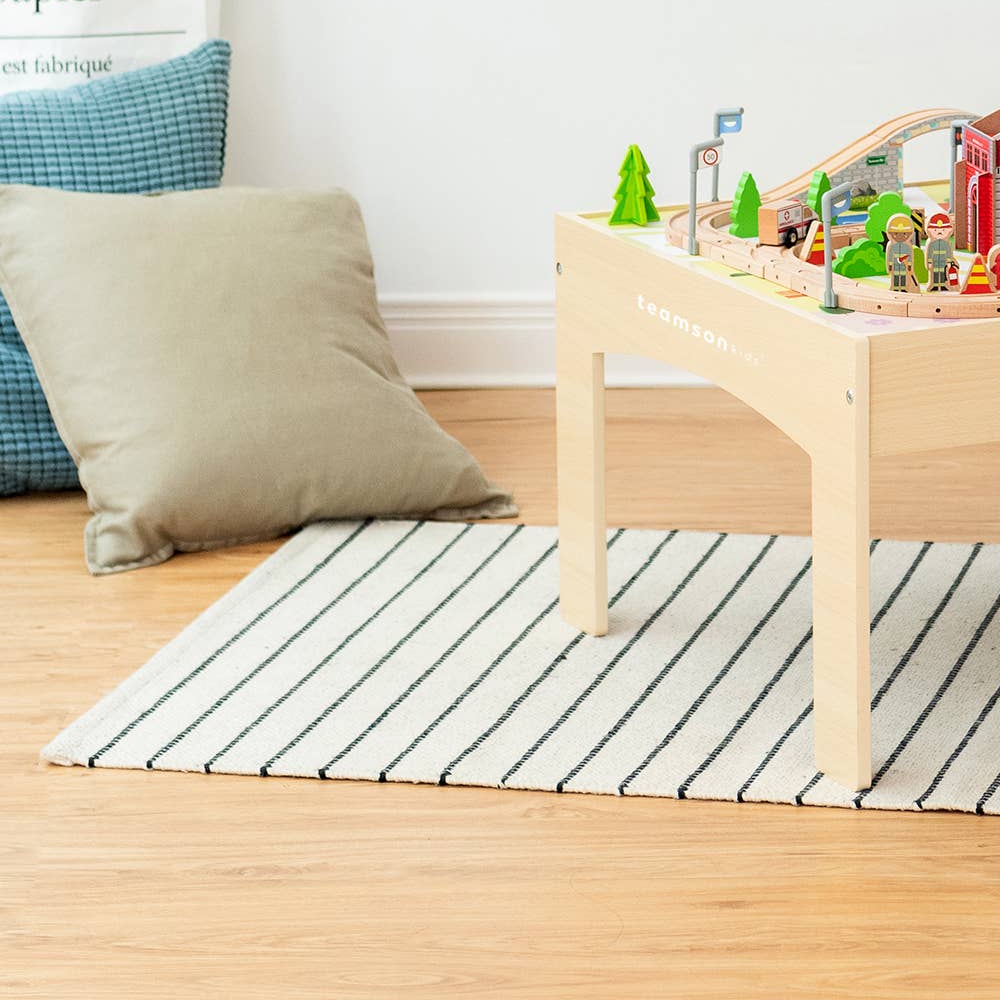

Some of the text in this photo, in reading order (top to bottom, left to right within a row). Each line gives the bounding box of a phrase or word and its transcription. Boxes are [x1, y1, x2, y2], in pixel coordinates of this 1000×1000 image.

[2, 53, 113, 79] est fabriqué
[637, 293, 728, 352] teamson
